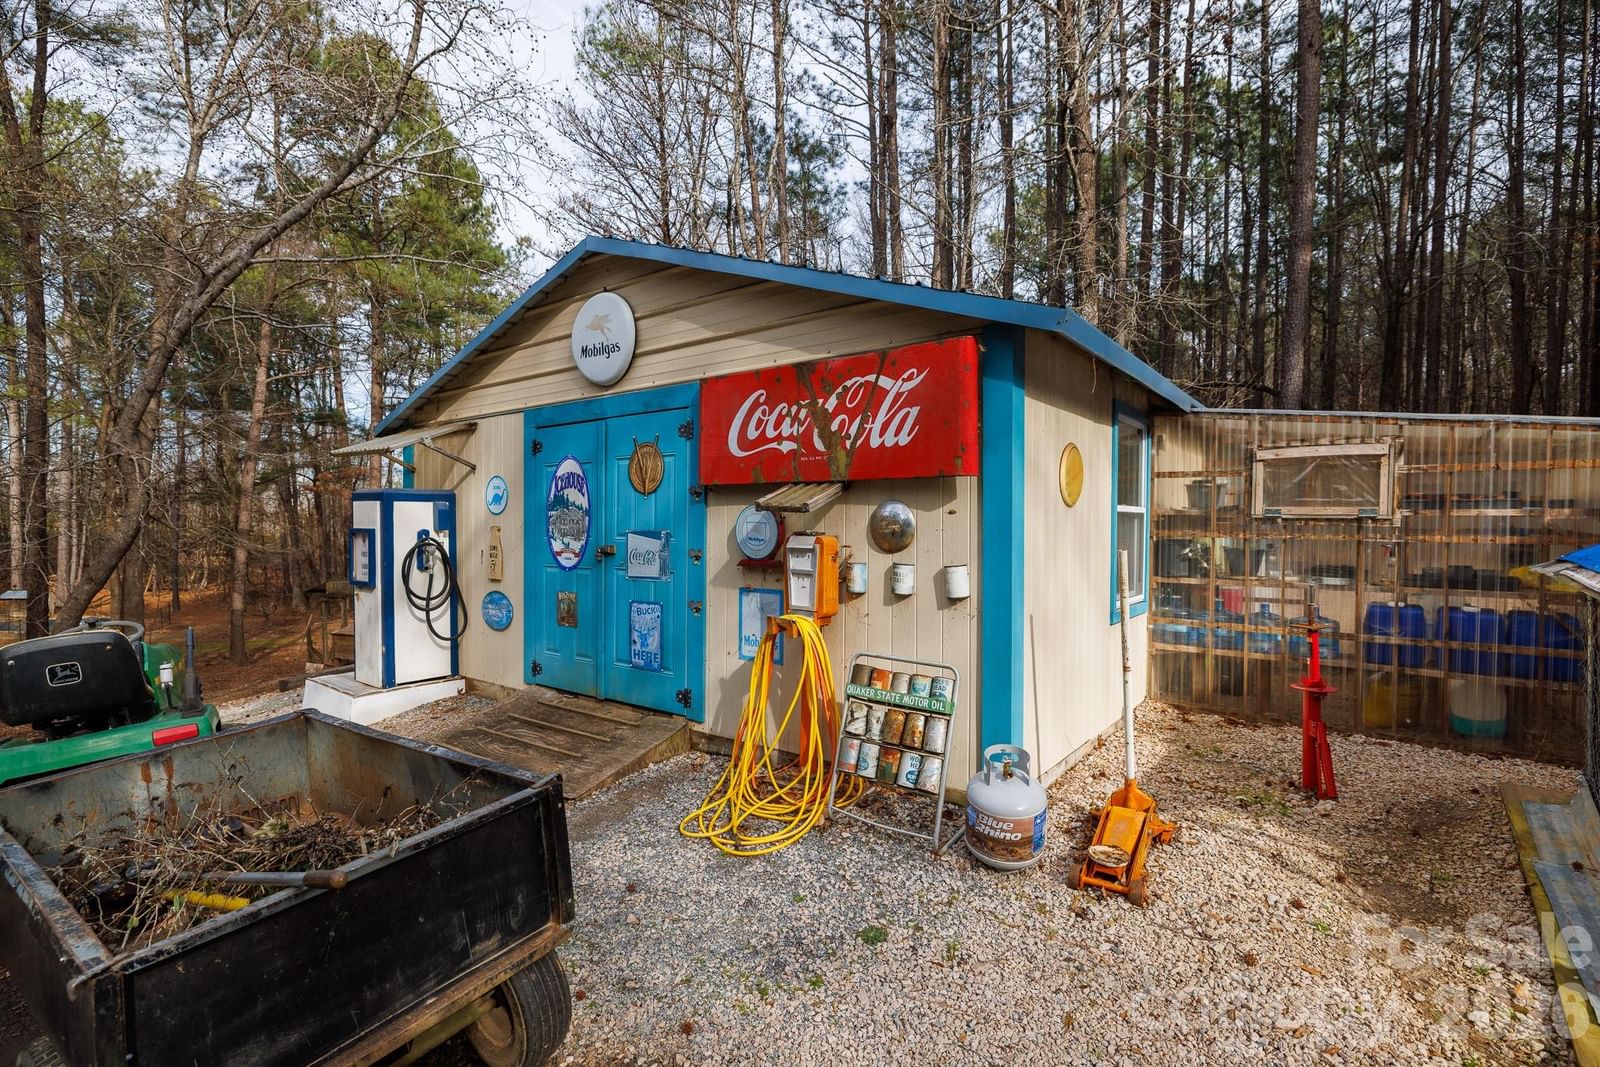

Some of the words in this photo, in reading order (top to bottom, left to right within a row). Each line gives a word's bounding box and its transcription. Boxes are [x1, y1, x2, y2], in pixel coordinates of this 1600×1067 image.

[580, 342, 621, 359] Mobilgas
[636, 607, 657, 616] BUCK
[633, 649, 660, 664] HERE
[846, 685, 875, 698] QUAKER
[876, 691, 901, 703] STATE
[902, 696, 929, 709] MOTOR
[931, 701, 945, 711] OIL
[978, 812, 1014, 830] Blue
[974, 823, 1022, 841] Rhino
